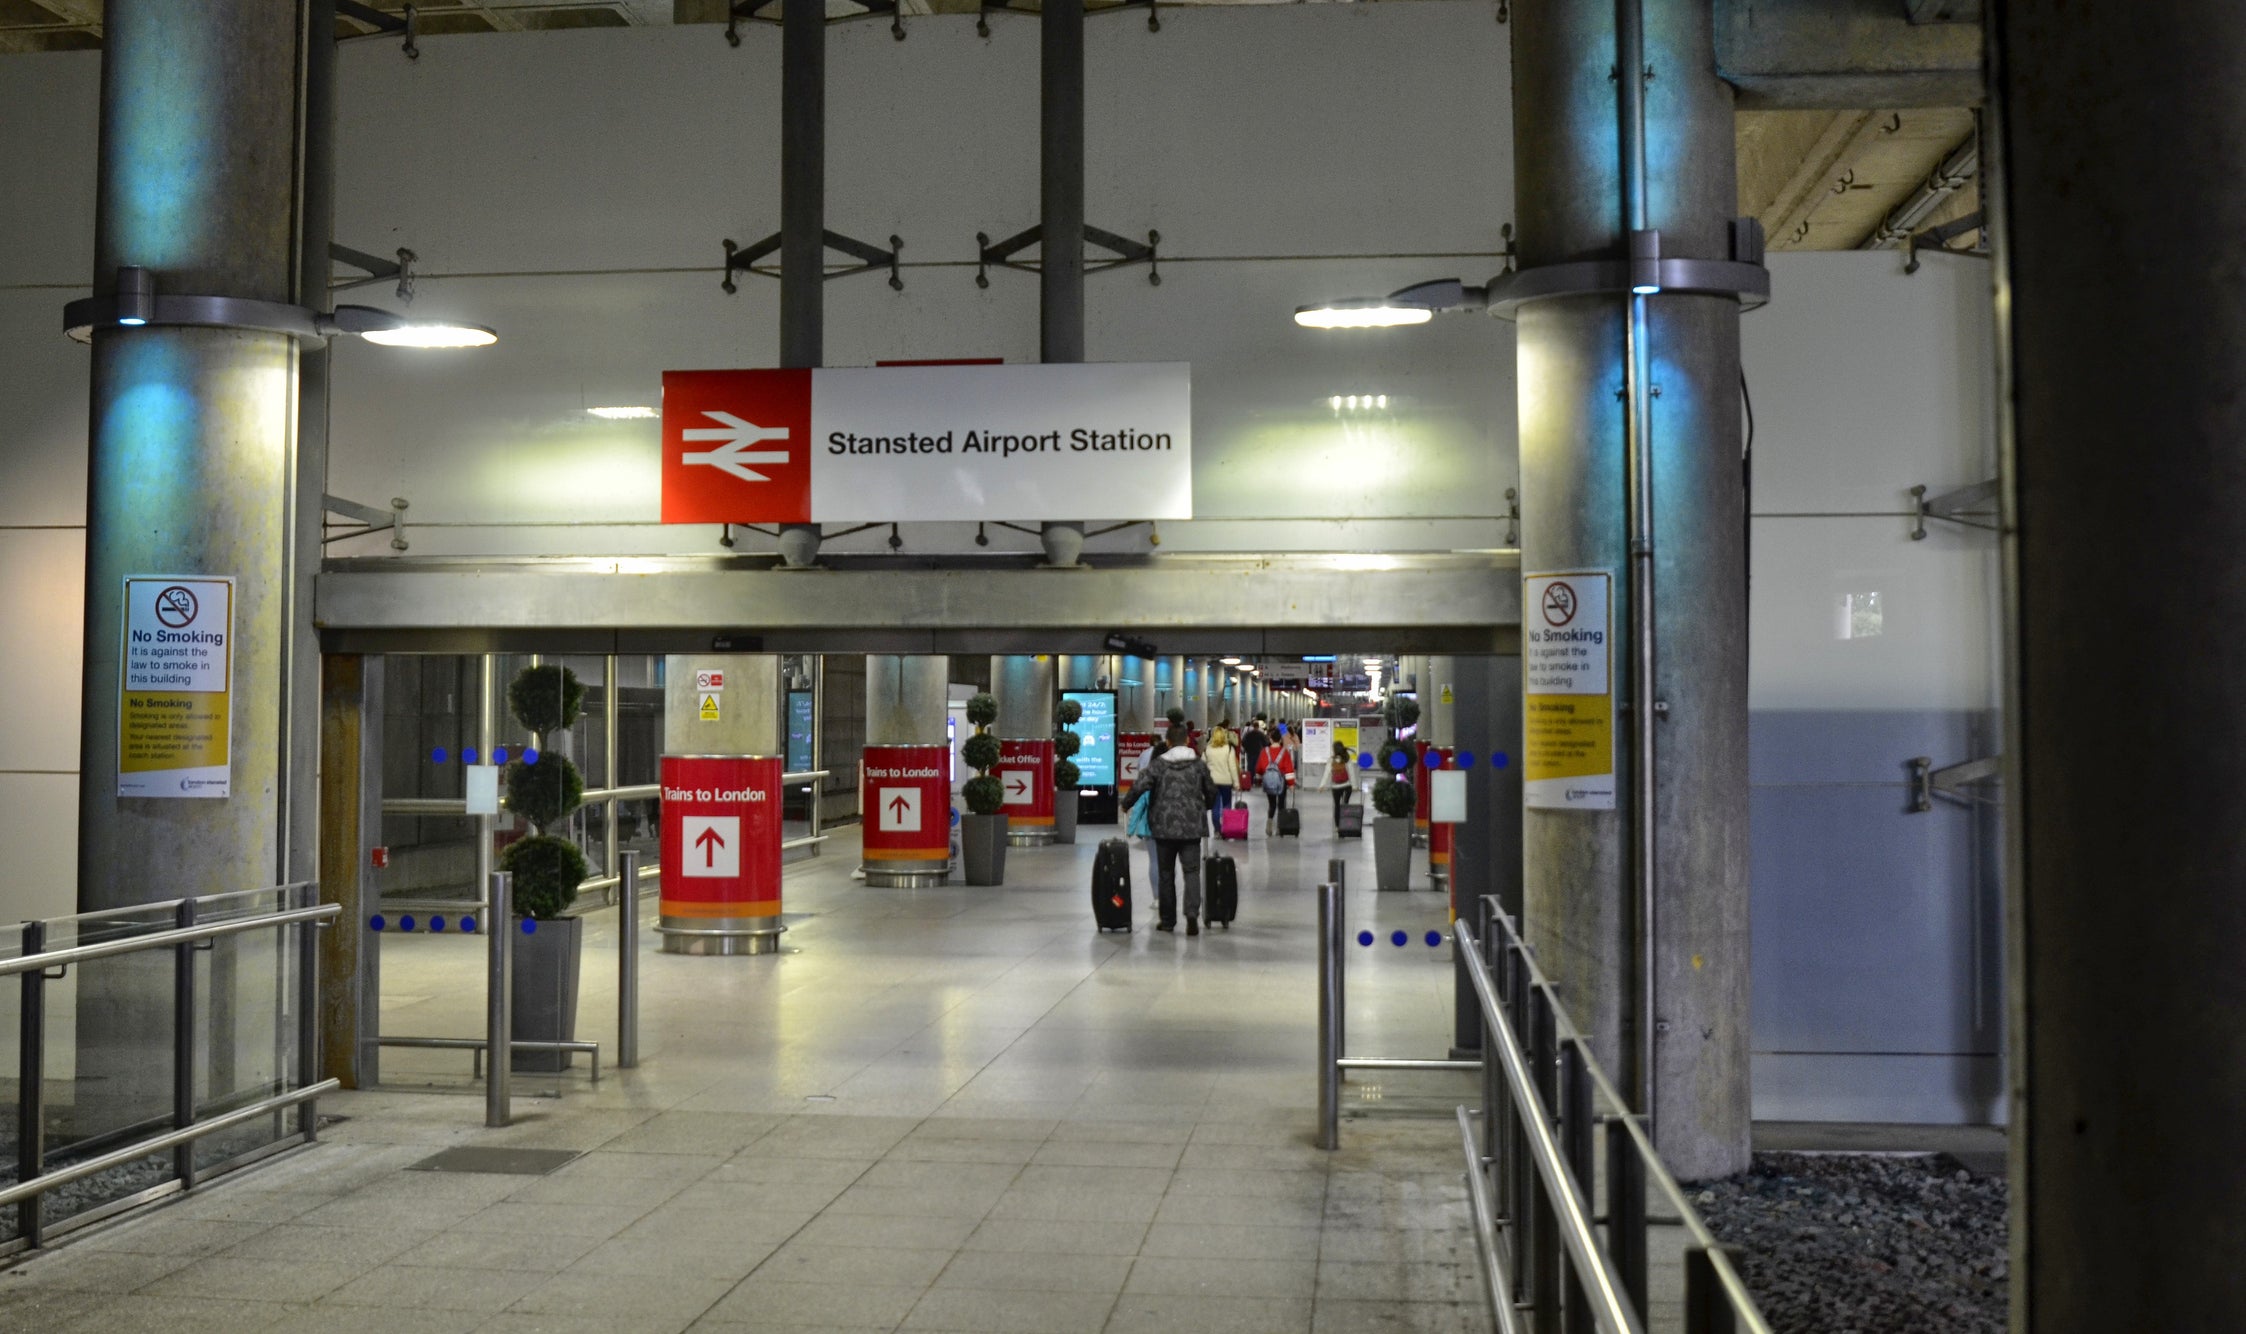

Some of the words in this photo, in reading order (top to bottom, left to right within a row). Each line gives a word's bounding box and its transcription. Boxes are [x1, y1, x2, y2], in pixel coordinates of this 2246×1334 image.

[828, 431, 952, 455] Stansted
[962, 430, 1061, 457] Airport
[1069, 429, 1172, 451] Station
[132, 630, 152, 642] No
[157, 630, 223, 646] Smoking
[1529, 631, 1540, 642] No
[1543, 628, 1603, 644] Smoking
[131, 647, 137, 656] It
[140, 648, 148, 656] is
[151, 648, 188, 658] against
[191, 648, 208, 656] the
[1540, 647, 1568, 658] against
[1571, 646, 1587, 656] the
[131, 660, 146, 670] law
[150, 661, 160, 670] to
[163, 661, 198, 670] smoke
[201, 661, 210, 670] in
[1548, 661, 1578, 671] smoke
[1580, 662, 1590, 671] in
[131, 674, 148, 683] this
[151, 674, 191, 686] building
[130, 698, 144, 708] No
[147, 698, 193, 710] Smoking
[1016, 755, 1041, 764] Office
[866, 767, 887, 777] Trains
[889, 768, 900, 777] to
[902, 767, 939, 777] London
[664, 787, 693, 801] Trains
[696, 789, 711, 801] to
[714, 787, 766, 801] London
